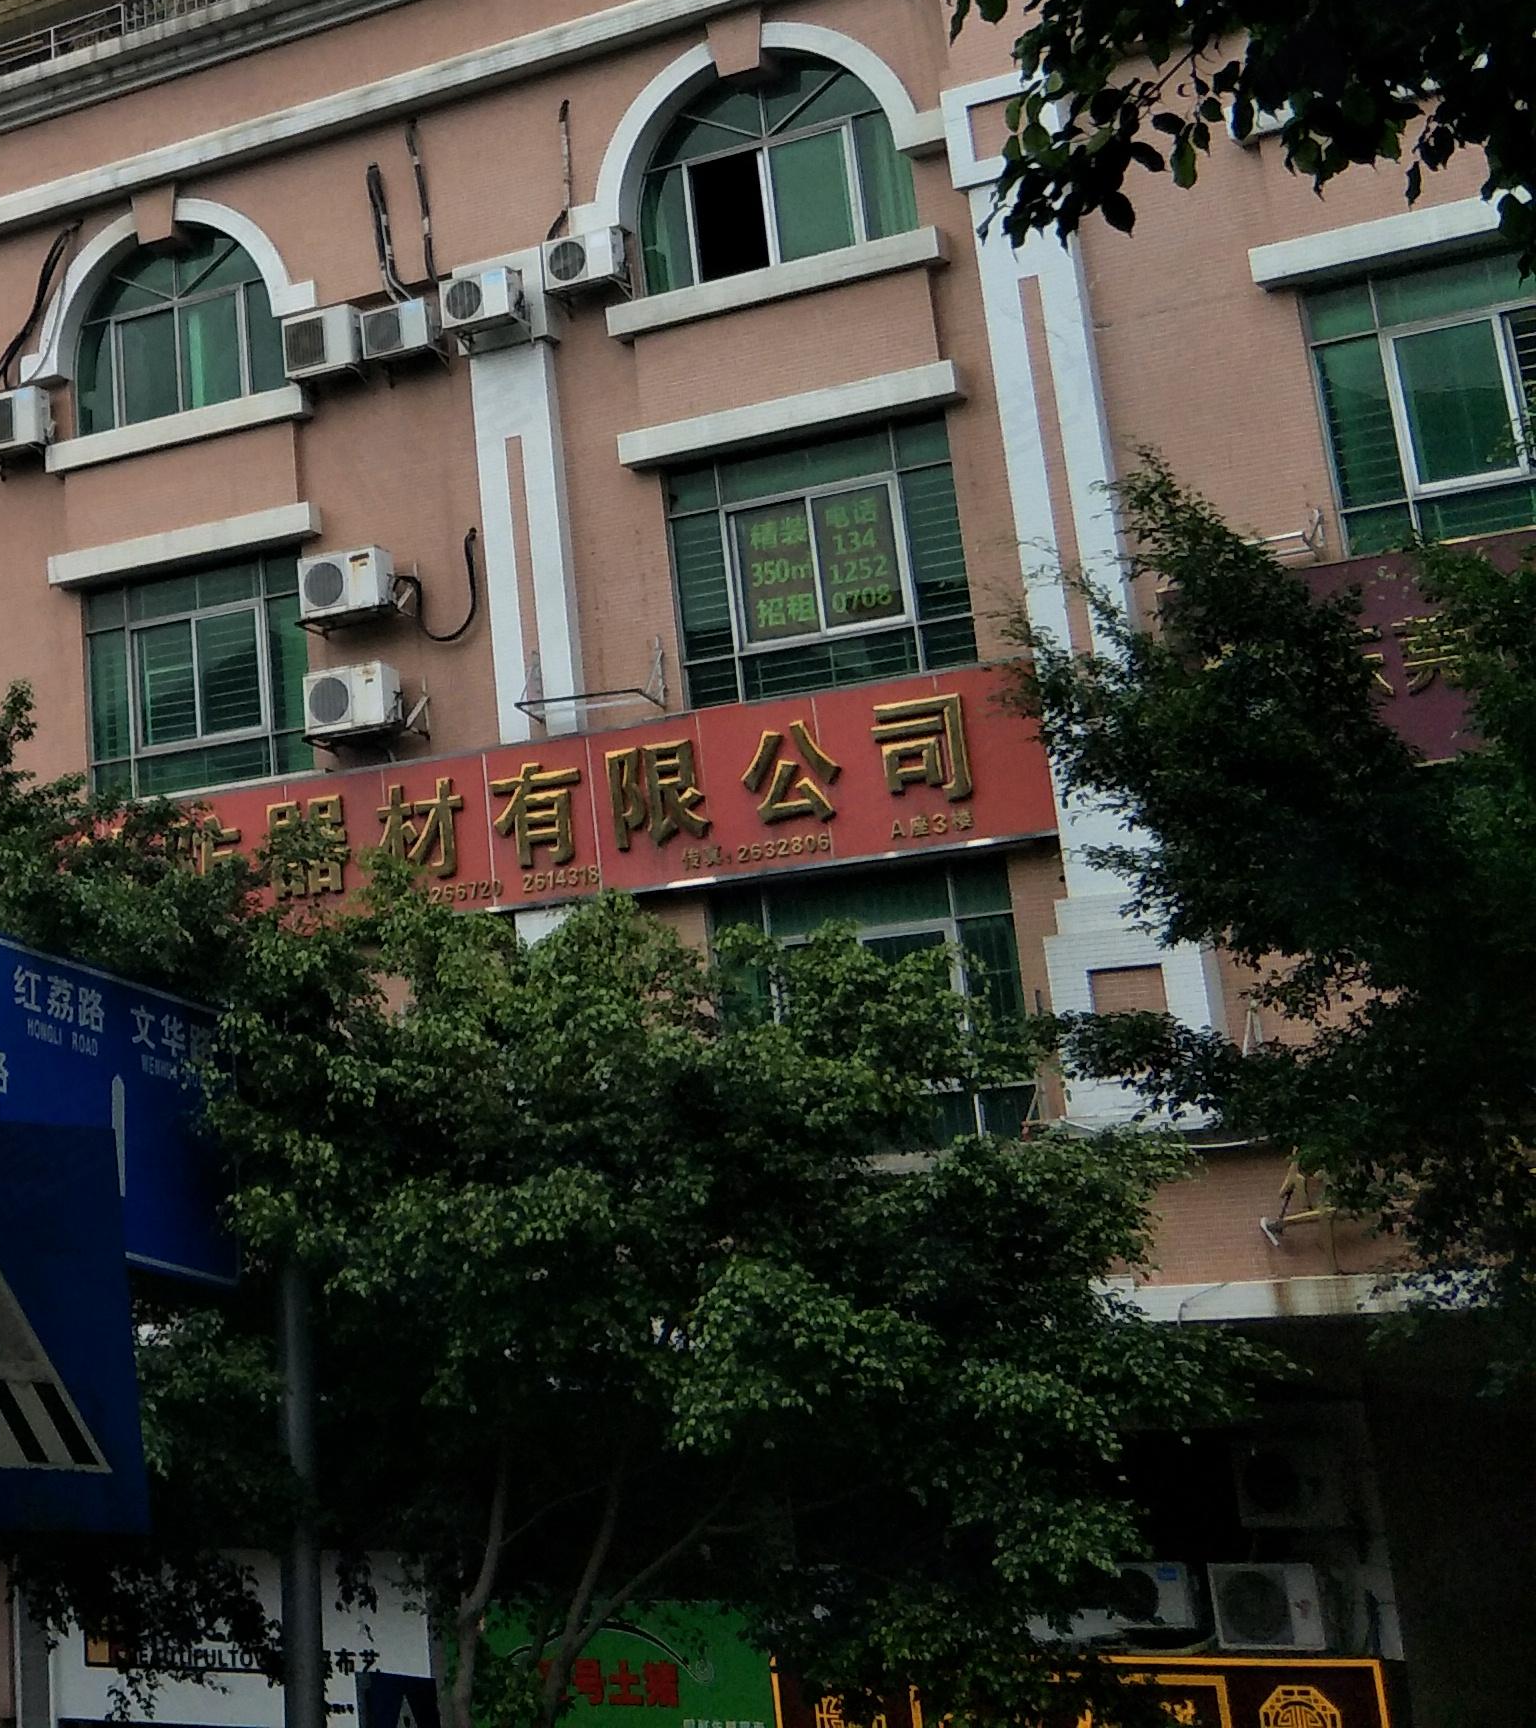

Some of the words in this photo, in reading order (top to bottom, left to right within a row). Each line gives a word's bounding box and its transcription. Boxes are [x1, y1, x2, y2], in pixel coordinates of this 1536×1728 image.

[824, 496, 878, 529] 电话
[750, 516, 808, 551] 精装
[832, 527, 877, 556] 134
[830, 555, 888, 585] 1252
[756, 592, 817, 629] 招租
[832, 583, 893, 614] 0708
[425, 878, 505, 906] 266720
[522, 864, 601, 893] 2614318
[13, 965, 106, 1034] 红荔路
[27, 1018, 64, 1047] HONGLI
[71, 1031, 99, 1058] ROAD
[130, 1004, 214, 1062] 文华路
